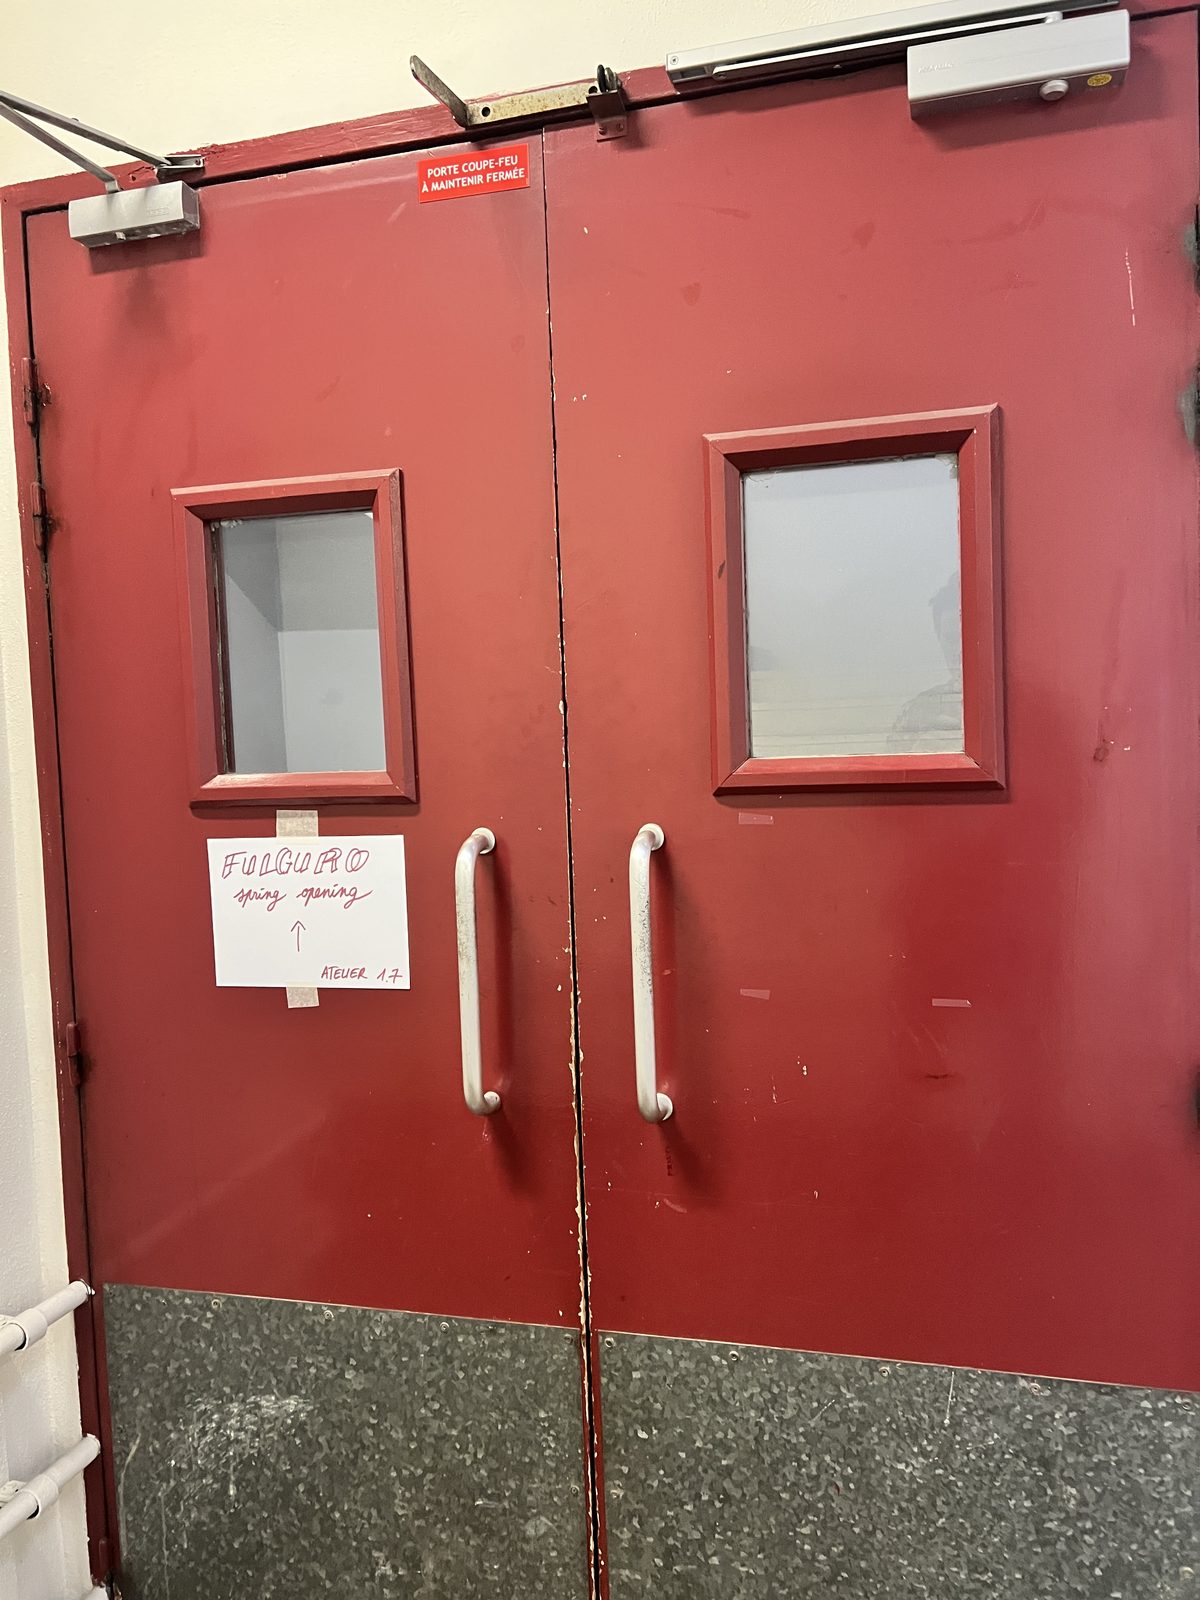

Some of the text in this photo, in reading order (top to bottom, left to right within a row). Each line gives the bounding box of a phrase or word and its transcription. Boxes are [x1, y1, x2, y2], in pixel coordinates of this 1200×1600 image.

[421, 167, 525, 193] À MAINTENIR FERMÉE
[427, 155, 518, 179] PORTE COUPE-FEU
[222, 847, 370, 879] FULGURO
[233, 884, 374, 911] spring opening
[321, 966, 403, 983] ATELIER 1.7
